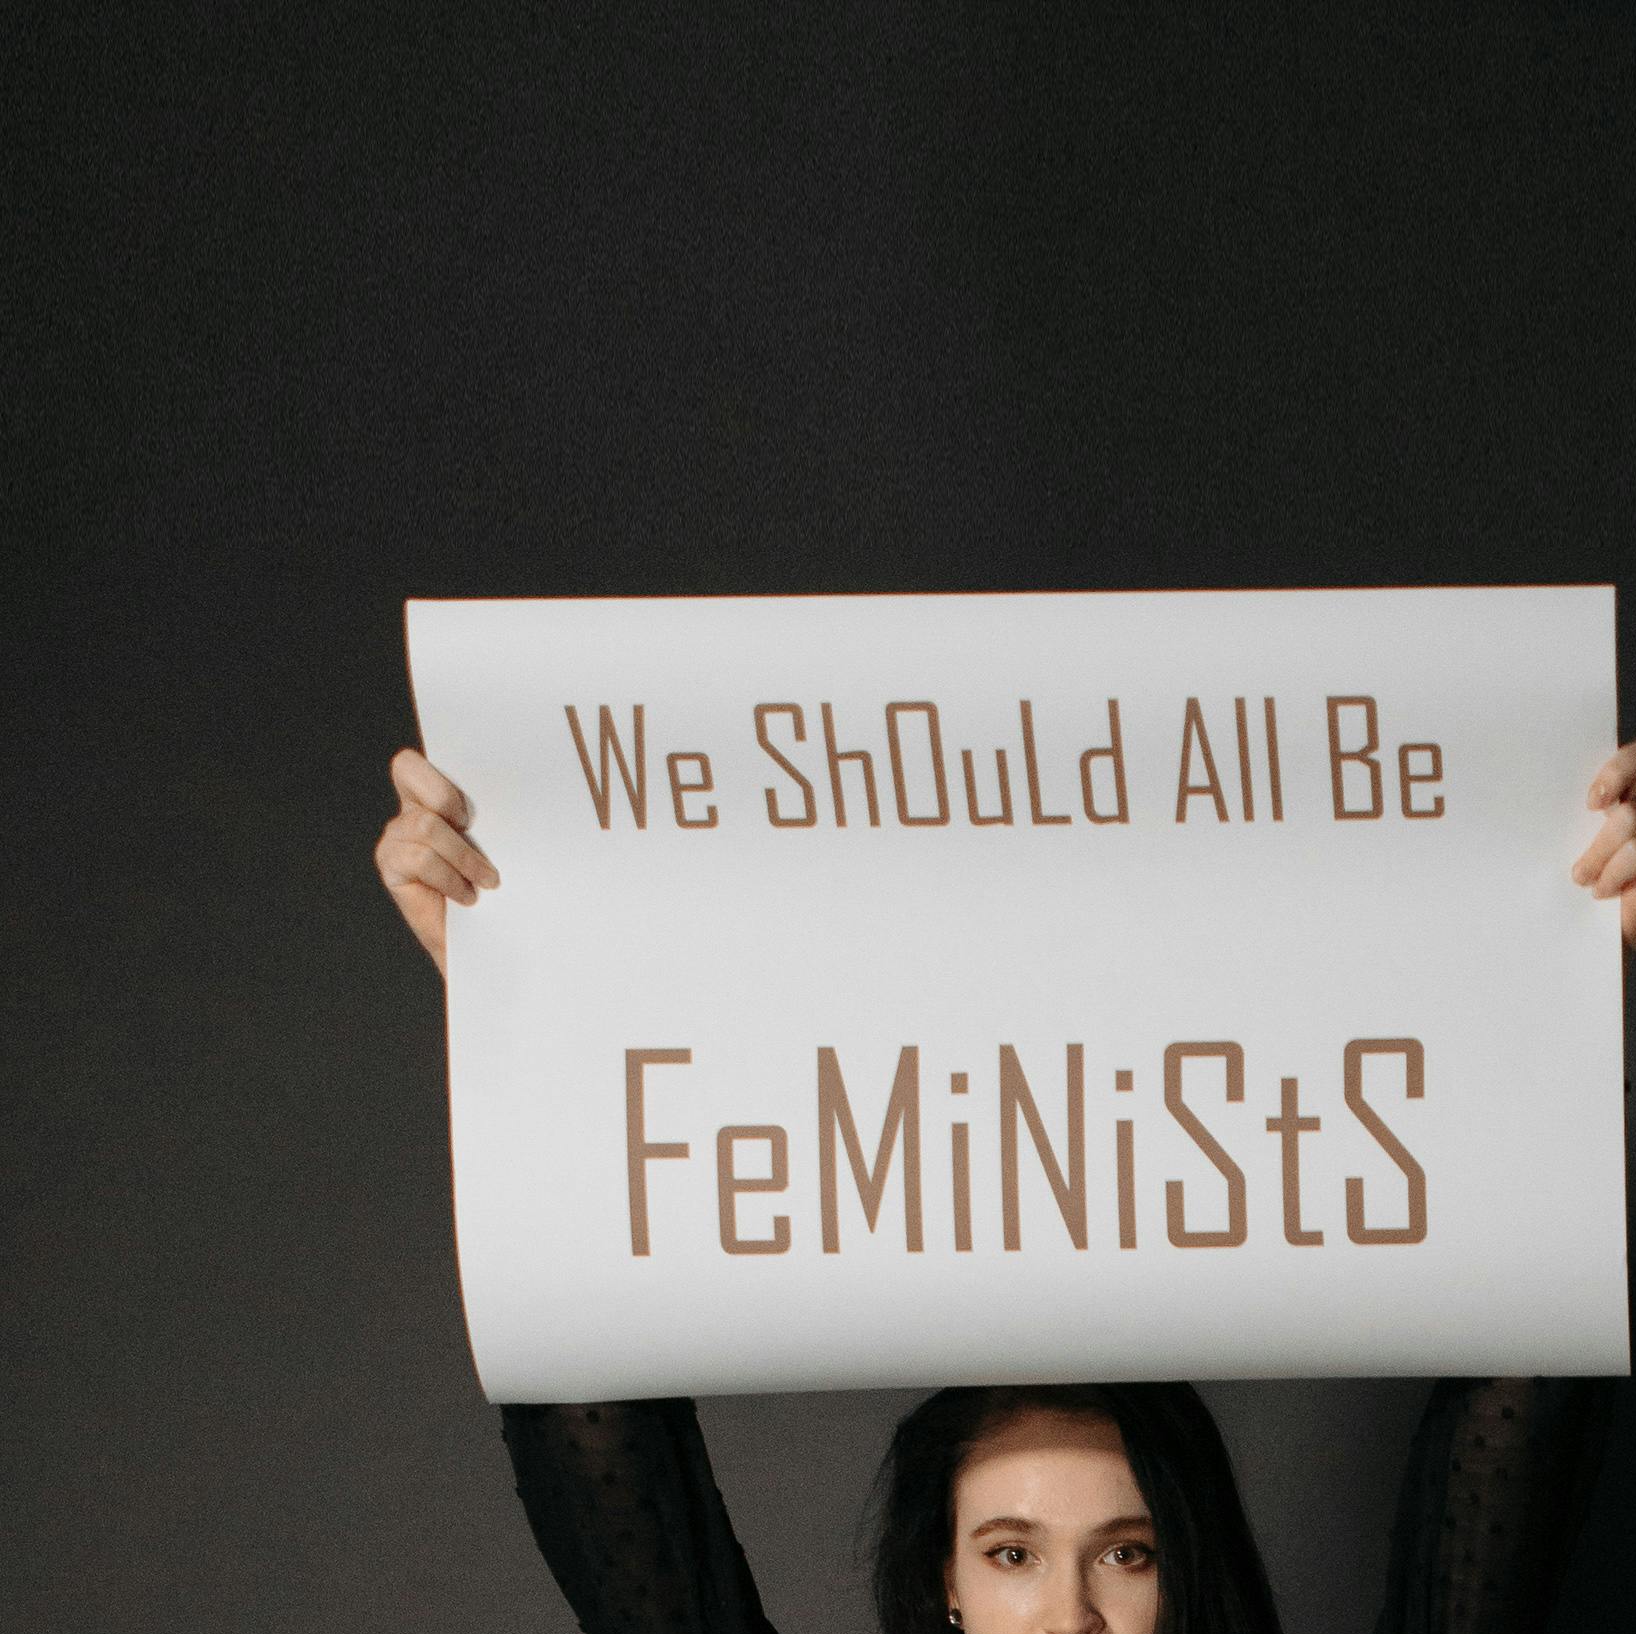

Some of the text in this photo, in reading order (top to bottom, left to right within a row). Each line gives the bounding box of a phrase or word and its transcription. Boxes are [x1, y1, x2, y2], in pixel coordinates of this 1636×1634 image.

[564, 695, 1446, 831] We ShOuLd All Be
[623, 1037, 1429, 1258] FeMiNiStS
